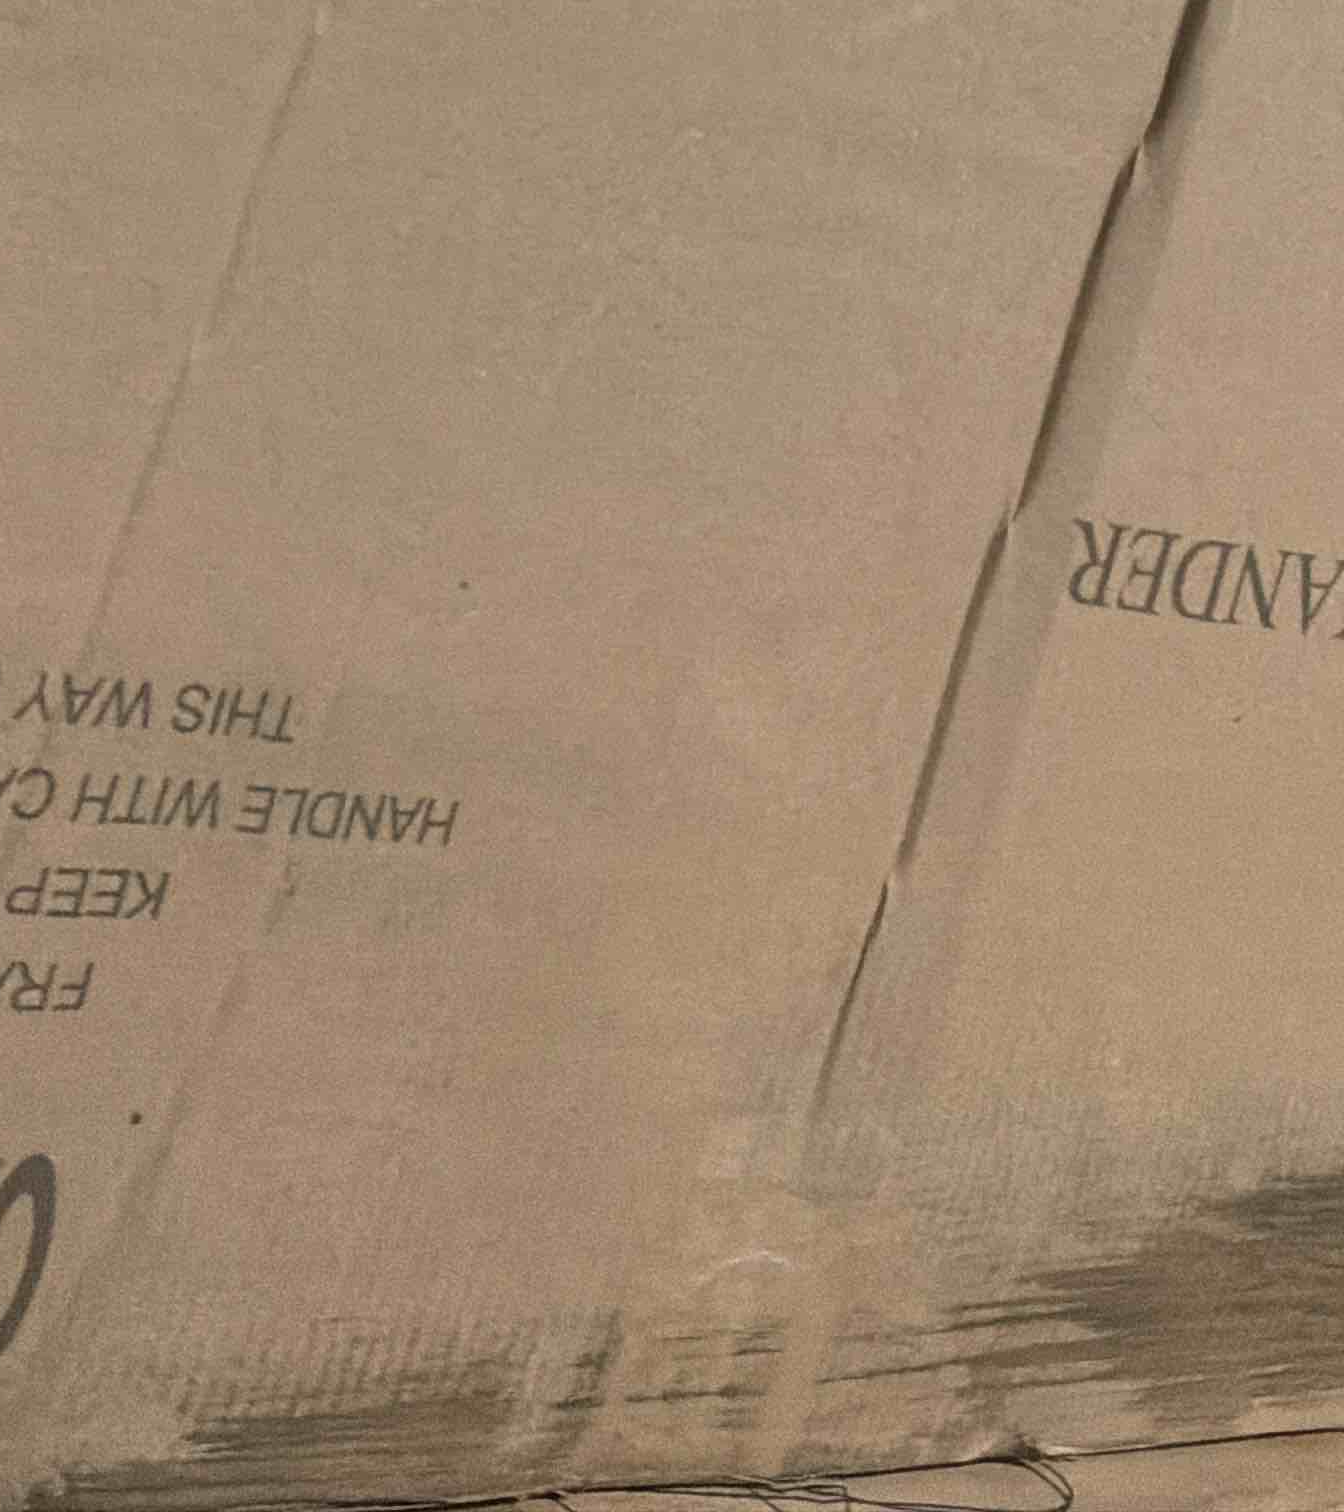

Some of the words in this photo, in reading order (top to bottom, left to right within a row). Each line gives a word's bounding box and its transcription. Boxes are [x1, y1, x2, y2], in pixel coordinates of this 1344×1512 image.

[13, 670, 153, 731] WAY
[171, 682, 296, 744] THIS
[72, 772, 222, 829] WITH
[237, 785, 459, 846] HANDLE
[5, 863, 171, 920] KEEP
